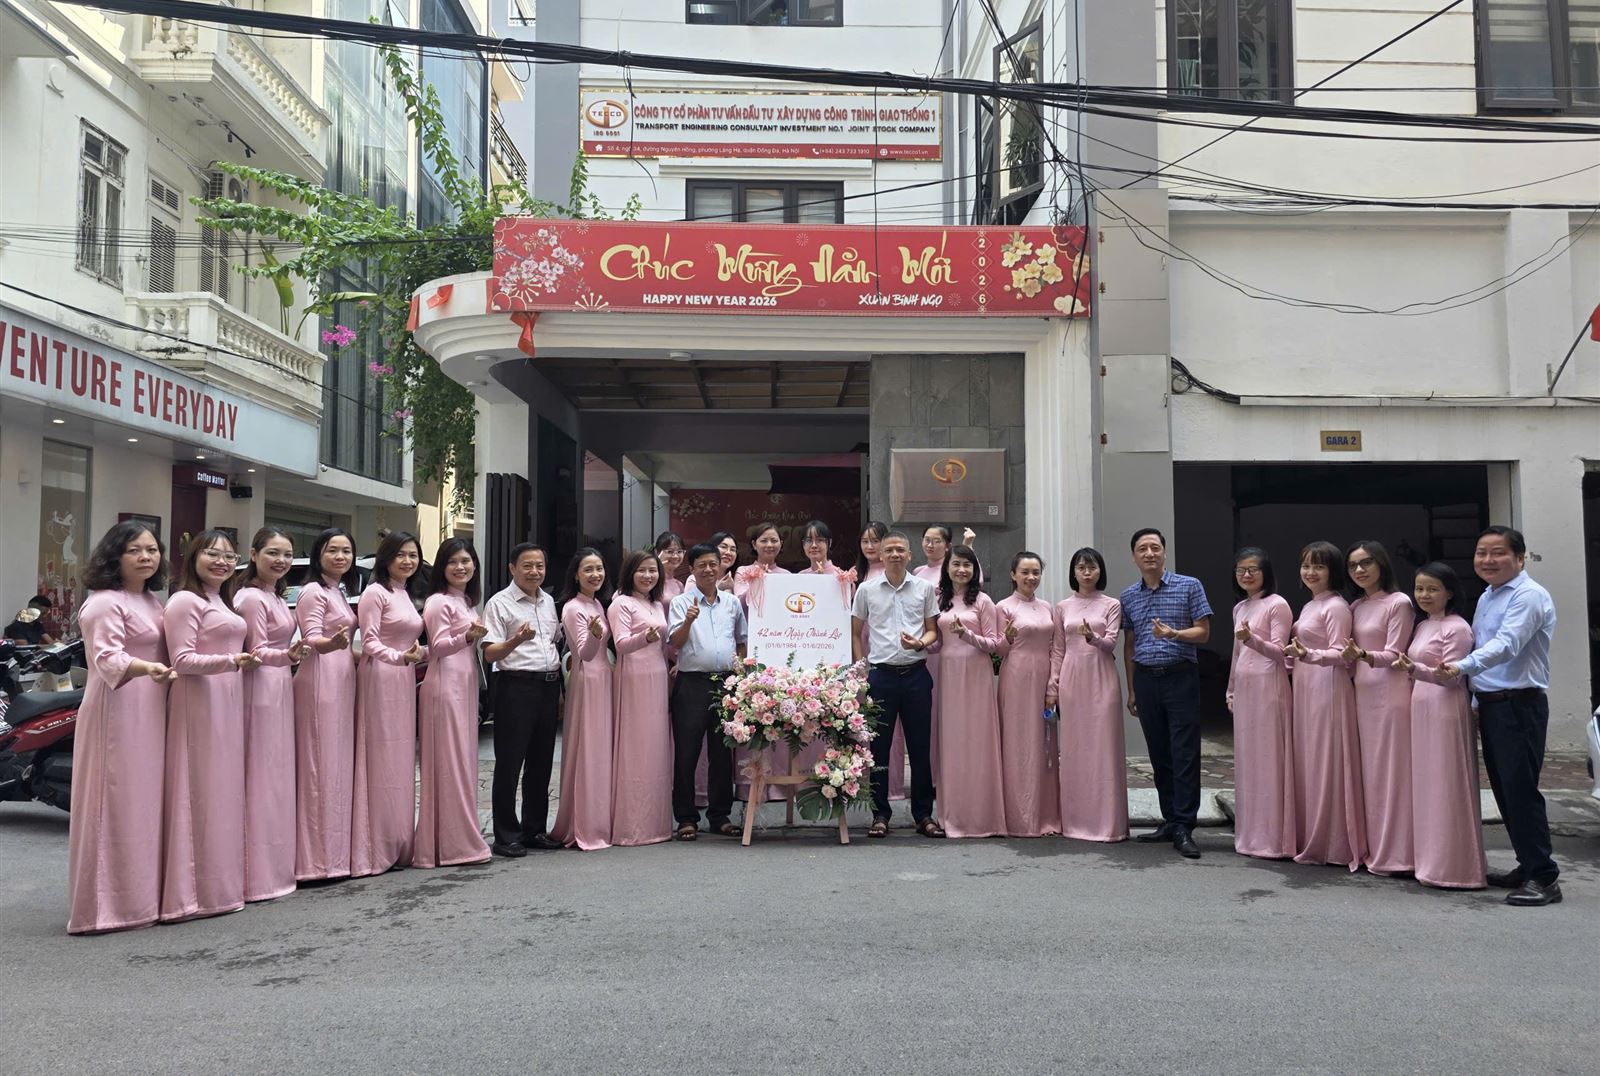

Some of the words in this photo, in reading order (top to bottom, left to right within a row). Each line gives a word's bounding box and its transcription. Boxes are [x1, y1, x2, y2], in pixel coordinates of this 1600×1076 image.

[634, 104, 658, 118] CÔNG
[660, 106, 672, 118] TY
[688, 104, 710, 120] PHẦN
[712, 107, 724, 120] TƯ
[762, 108, 774, 120] TƯ
[777, 106, 794, 120] XÂY
[796, 108, 821, 123] DỰNG
[824, 106, 848, 120] CÔNG
[851, 106, 876, 121] TRÌNH
[879, 109, 900, 121] GIAO
[901, 107, 929, 121] THÔNG
[932, 110, 935, 121] 1
[681, 123, 728, 131] ENGINEERING
[643, 294, 682, 305] HAPPY
[685, 295, 713, 305] NEW
[716, 296, 746, 306] YEAR
[749, 296, 777, 306] 2026
[921, 294, 943, 308] NGỌ
[134, 369, 238, 441] EVERYDAY
[1326, 436, 1348, 445] GARA
[1351, 436, 1357, 445] 2
[197, 472, 211, 483] Coffee
[757, 628, 769, 637] 42
